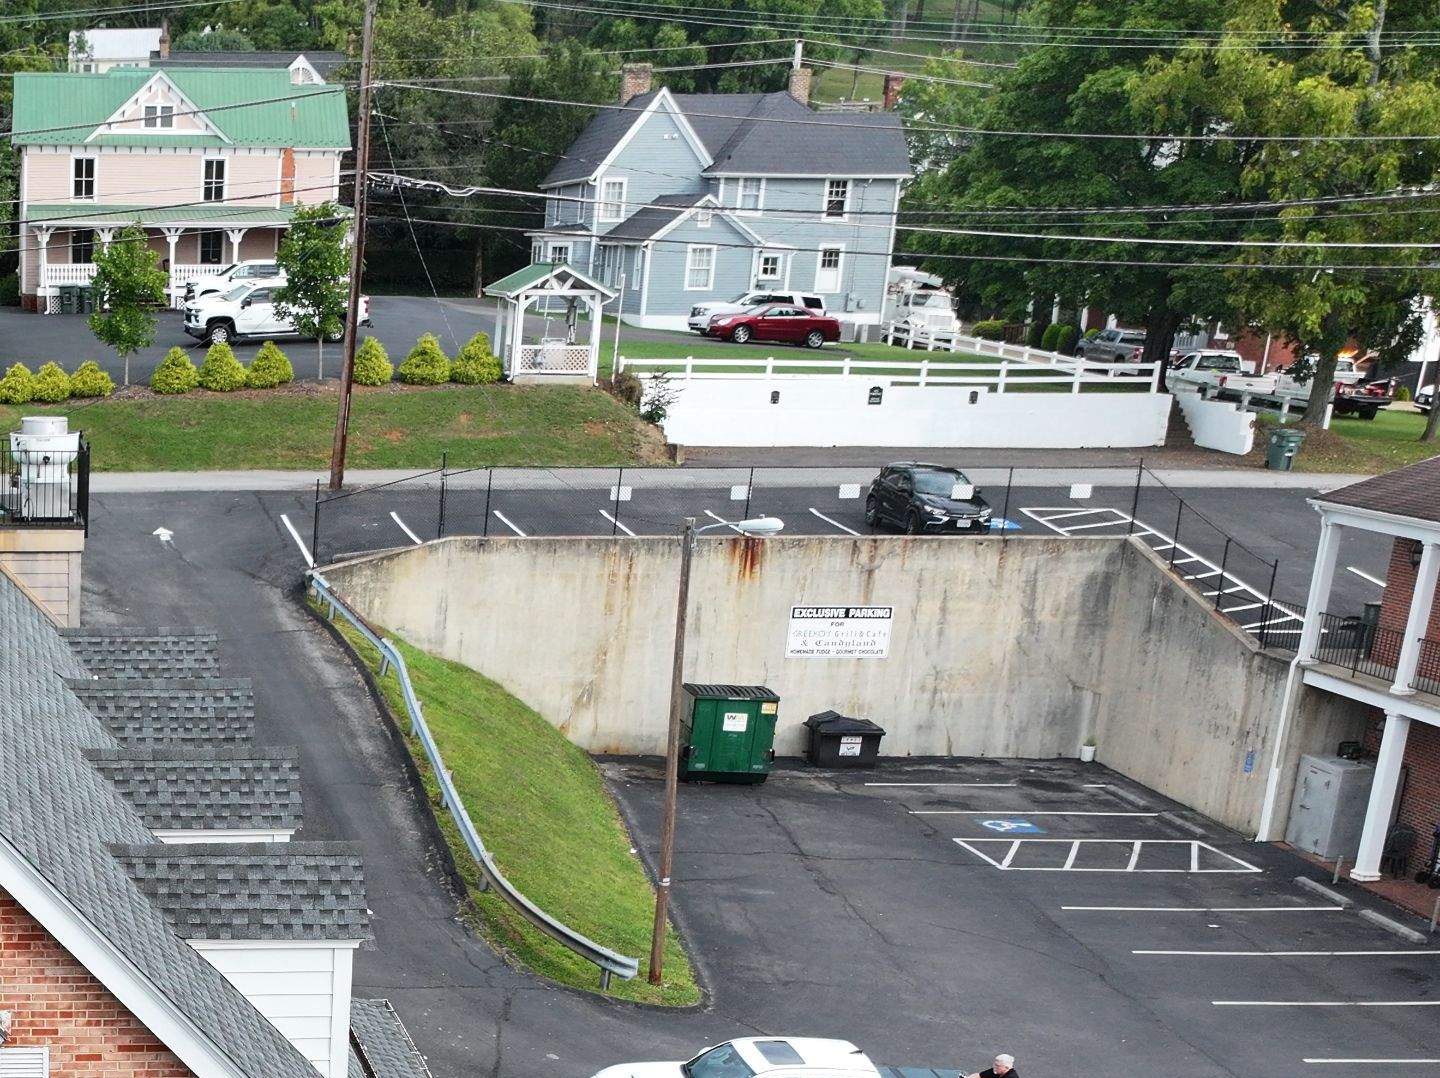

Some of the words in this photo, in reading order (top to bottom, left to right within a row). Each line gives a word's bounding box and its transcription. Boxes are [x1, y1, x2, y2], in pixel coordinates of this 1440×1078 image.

[794, 609, 845, 617] EXCLUSIVE
[849, 609, 890, 617] PARKING
[815, 639, 876, 648] Candyland
